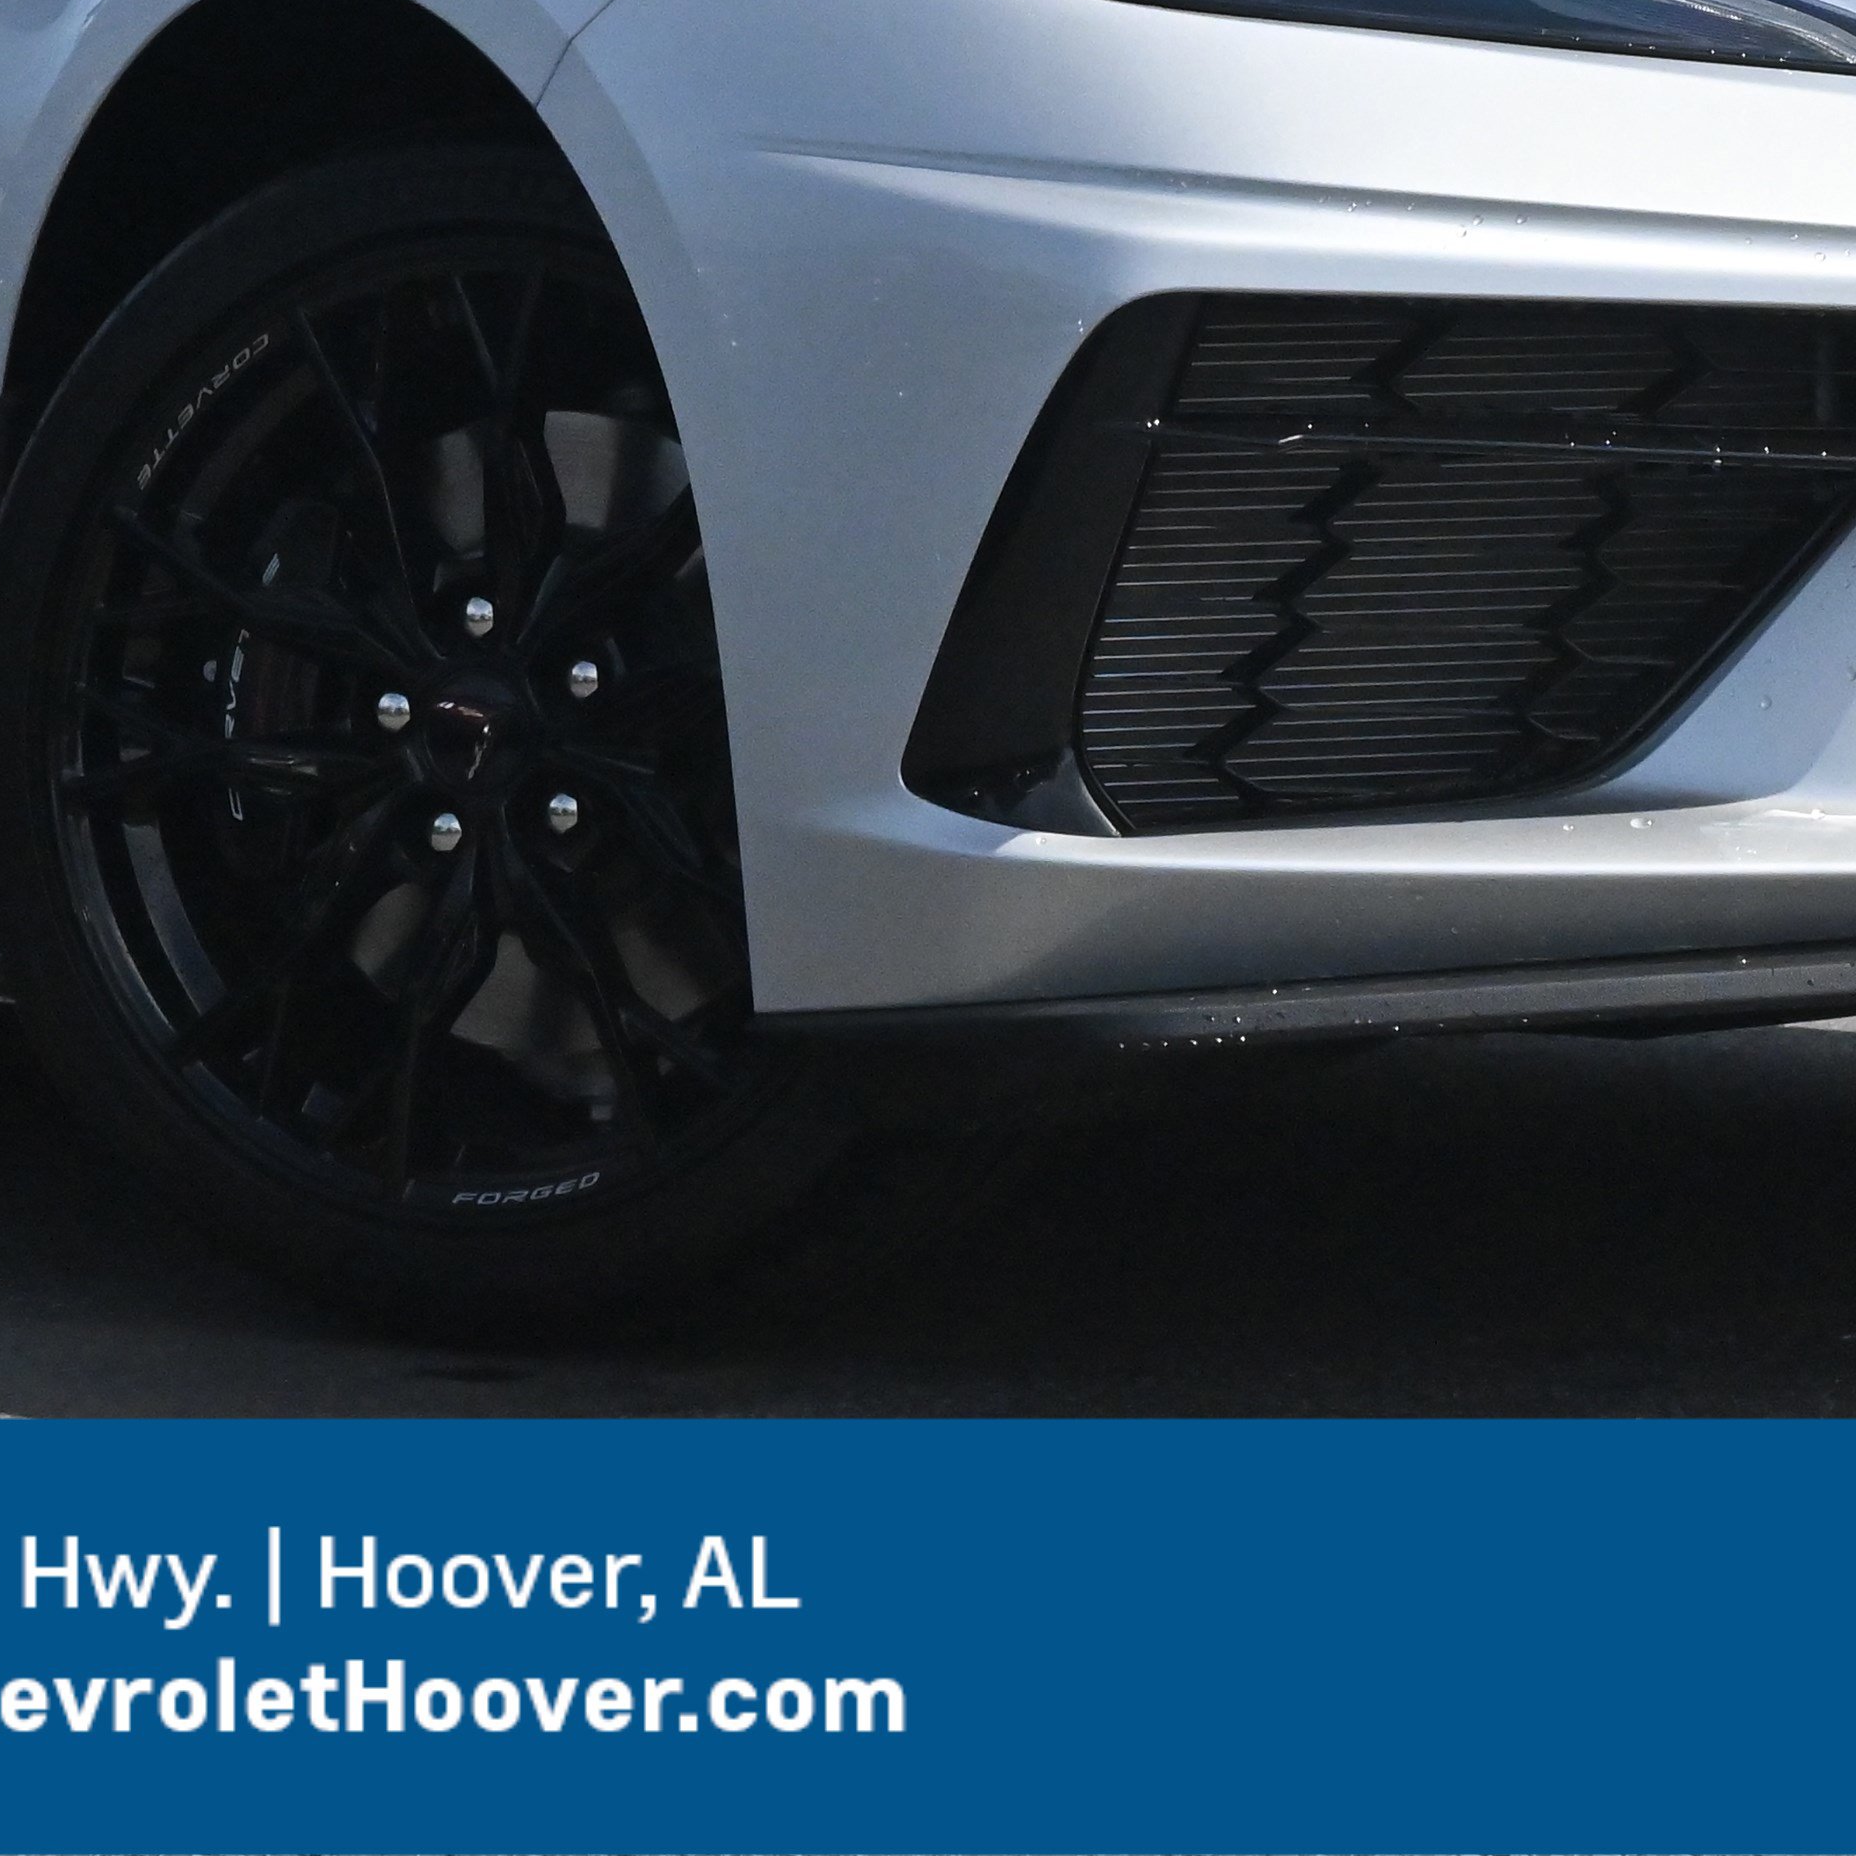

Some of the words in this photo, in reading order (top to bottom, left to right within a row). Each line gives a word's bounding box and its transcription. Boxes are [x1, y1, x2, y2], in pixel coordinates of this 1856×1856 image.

[136, 334, 269, 490] CORVETTE
[223, 552, 281, 822] CRVEE
[451, 1171, 601, 1205] FORGED
